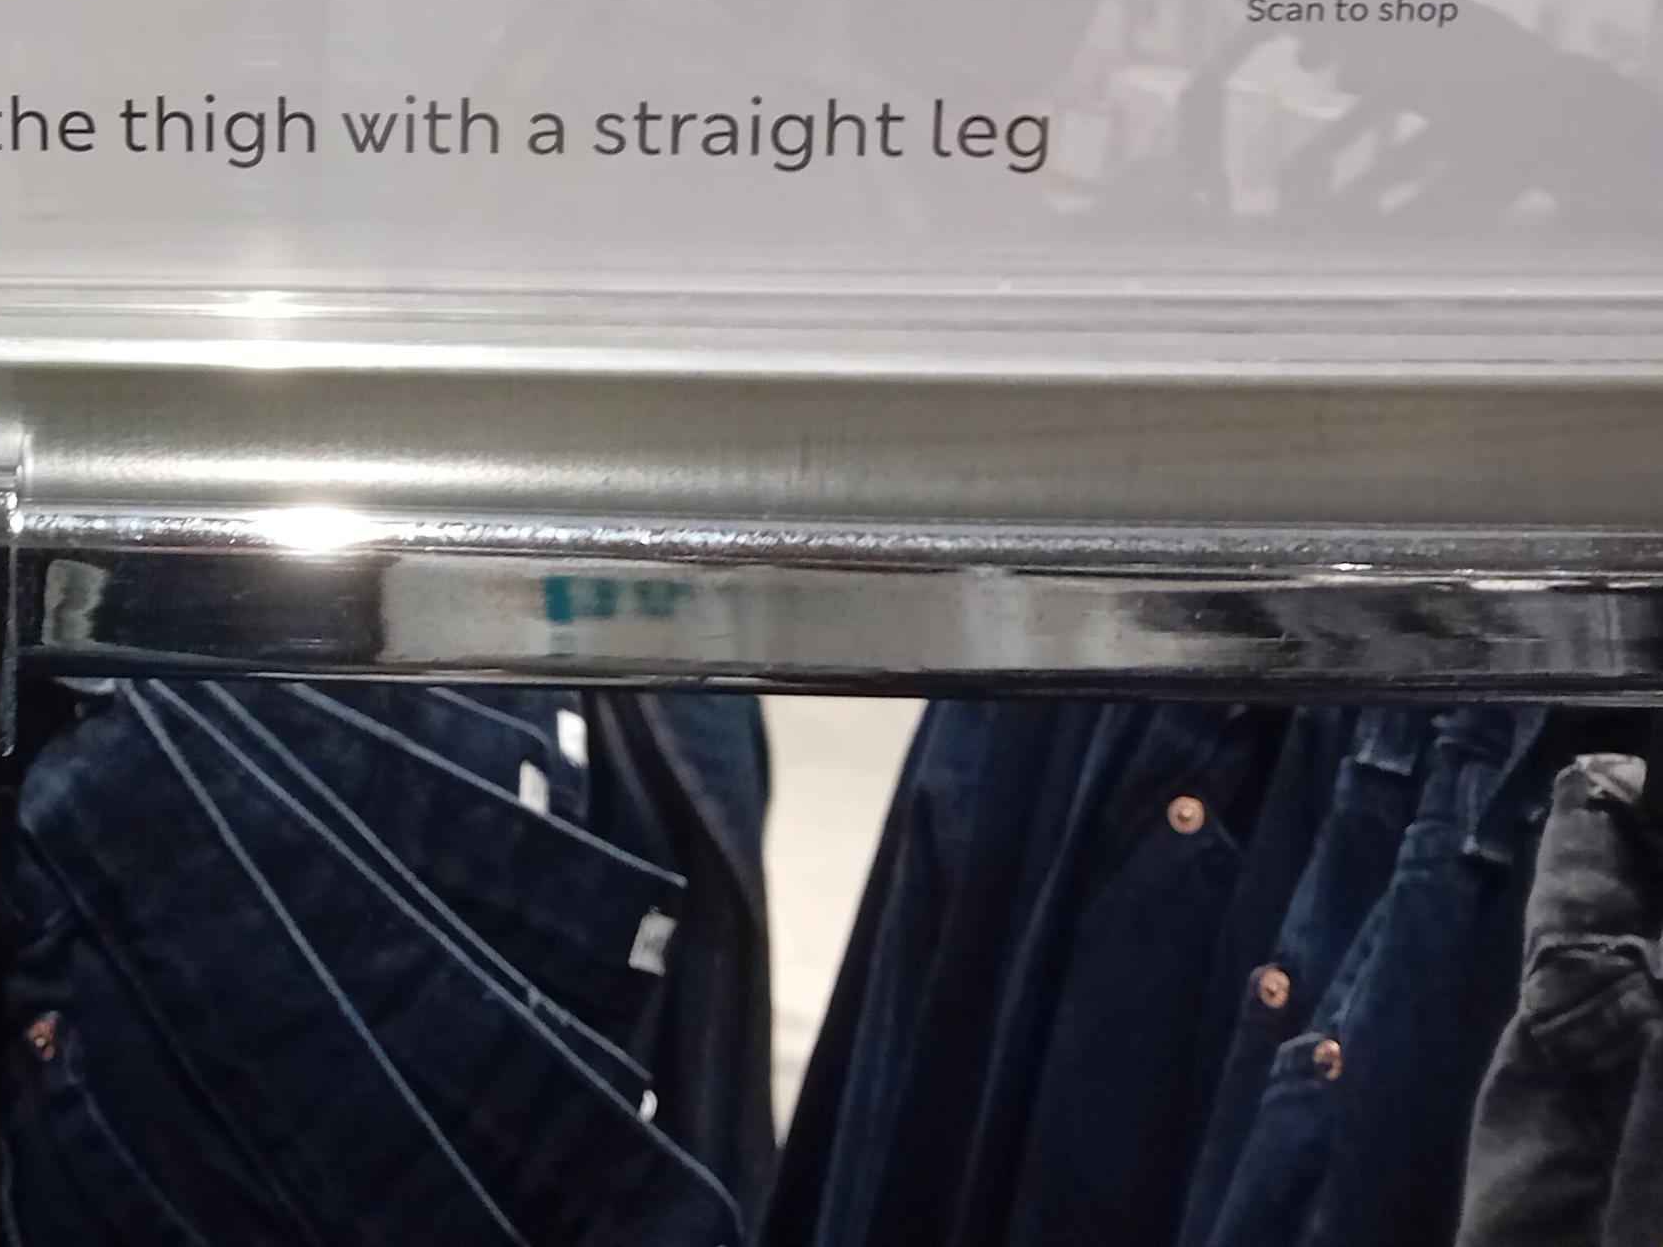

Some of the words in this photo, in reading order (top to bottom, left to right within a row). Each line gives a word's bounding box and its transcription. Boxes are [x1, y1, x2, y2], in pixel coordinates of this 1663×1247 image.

[119, 94, 315, 168] thigh
[342, 95, 499, 155] with
[526, 113, 566, 156] a
[593, 96, 905, 172] straight
[933, 97, 1051, 174] leg
